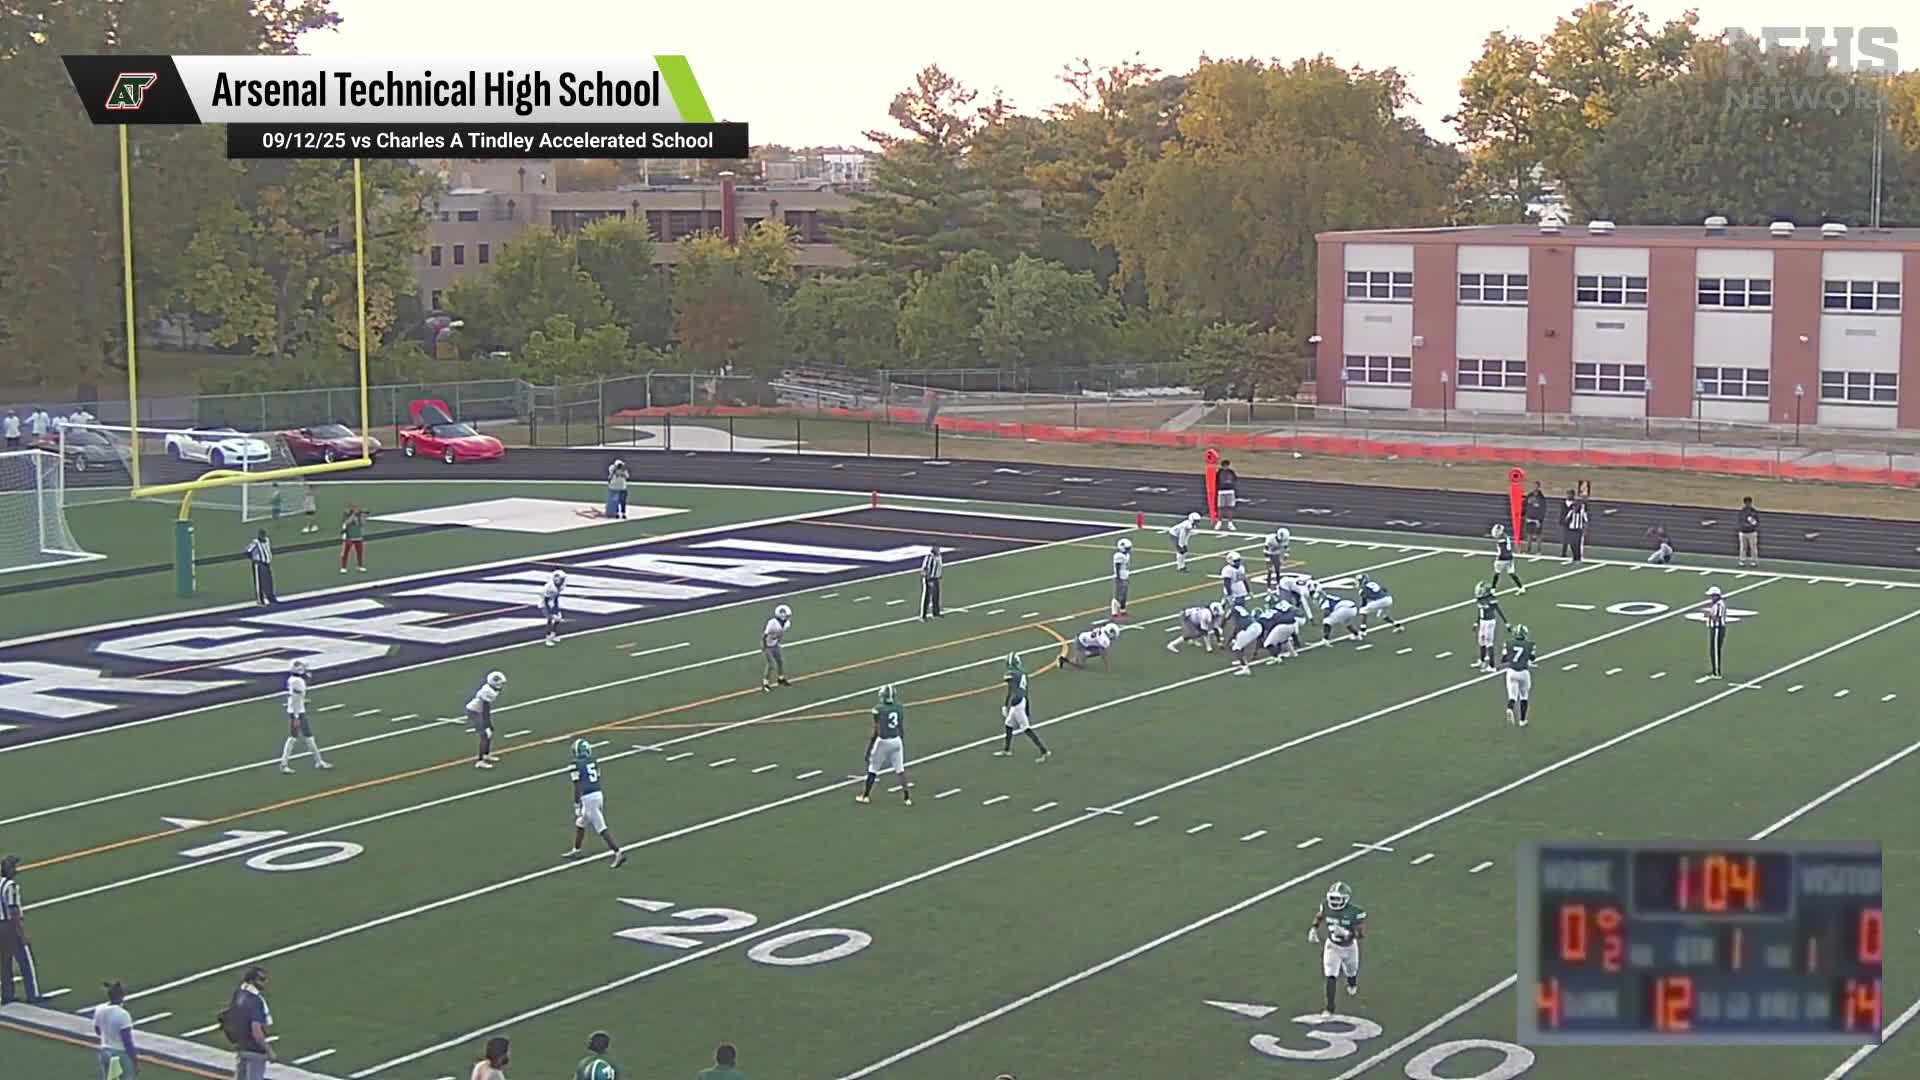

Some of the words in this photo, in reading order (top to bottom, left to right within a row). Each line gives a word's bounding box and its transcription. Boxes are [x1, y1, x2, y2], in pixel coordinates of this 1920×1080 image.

[1512, 646, 1525, 662] 7
[1019, 674, 1028, 690] 4
[888, 711, 898, 728] 3
[586, 763, 598, 782] 5
[178, 829, 365, 871] 10
[612, 907, 872, 966] 20
[1560, 904, 1588, 962] 0
[1859, 909, 1881, 964] 0
[1655, 976, 1693, 1031] 12
